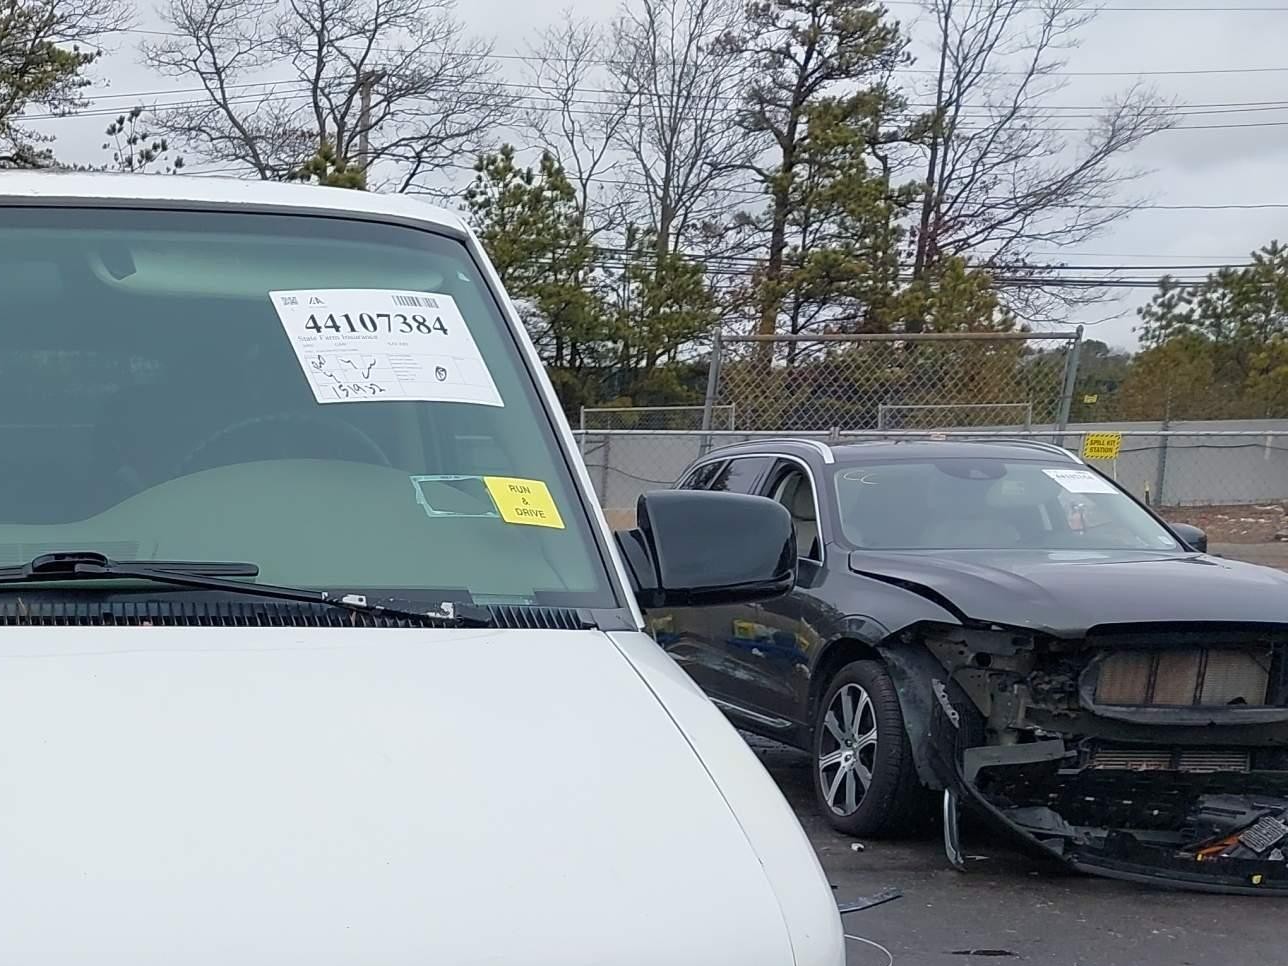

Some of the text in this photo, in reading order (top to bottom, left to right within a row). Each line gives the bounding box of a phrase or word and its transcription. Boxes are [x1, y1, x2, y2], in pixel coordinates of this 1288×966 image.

[304, 312, 448, 335] 44107384
[1106, 439, 1116, 447] KIT
[1089, 446, 1113, 454] STATION
[508, 484, 531, 495] RUN
[521, 497, 530, 506] &
[515, 507, 547, 519] DRIVE
